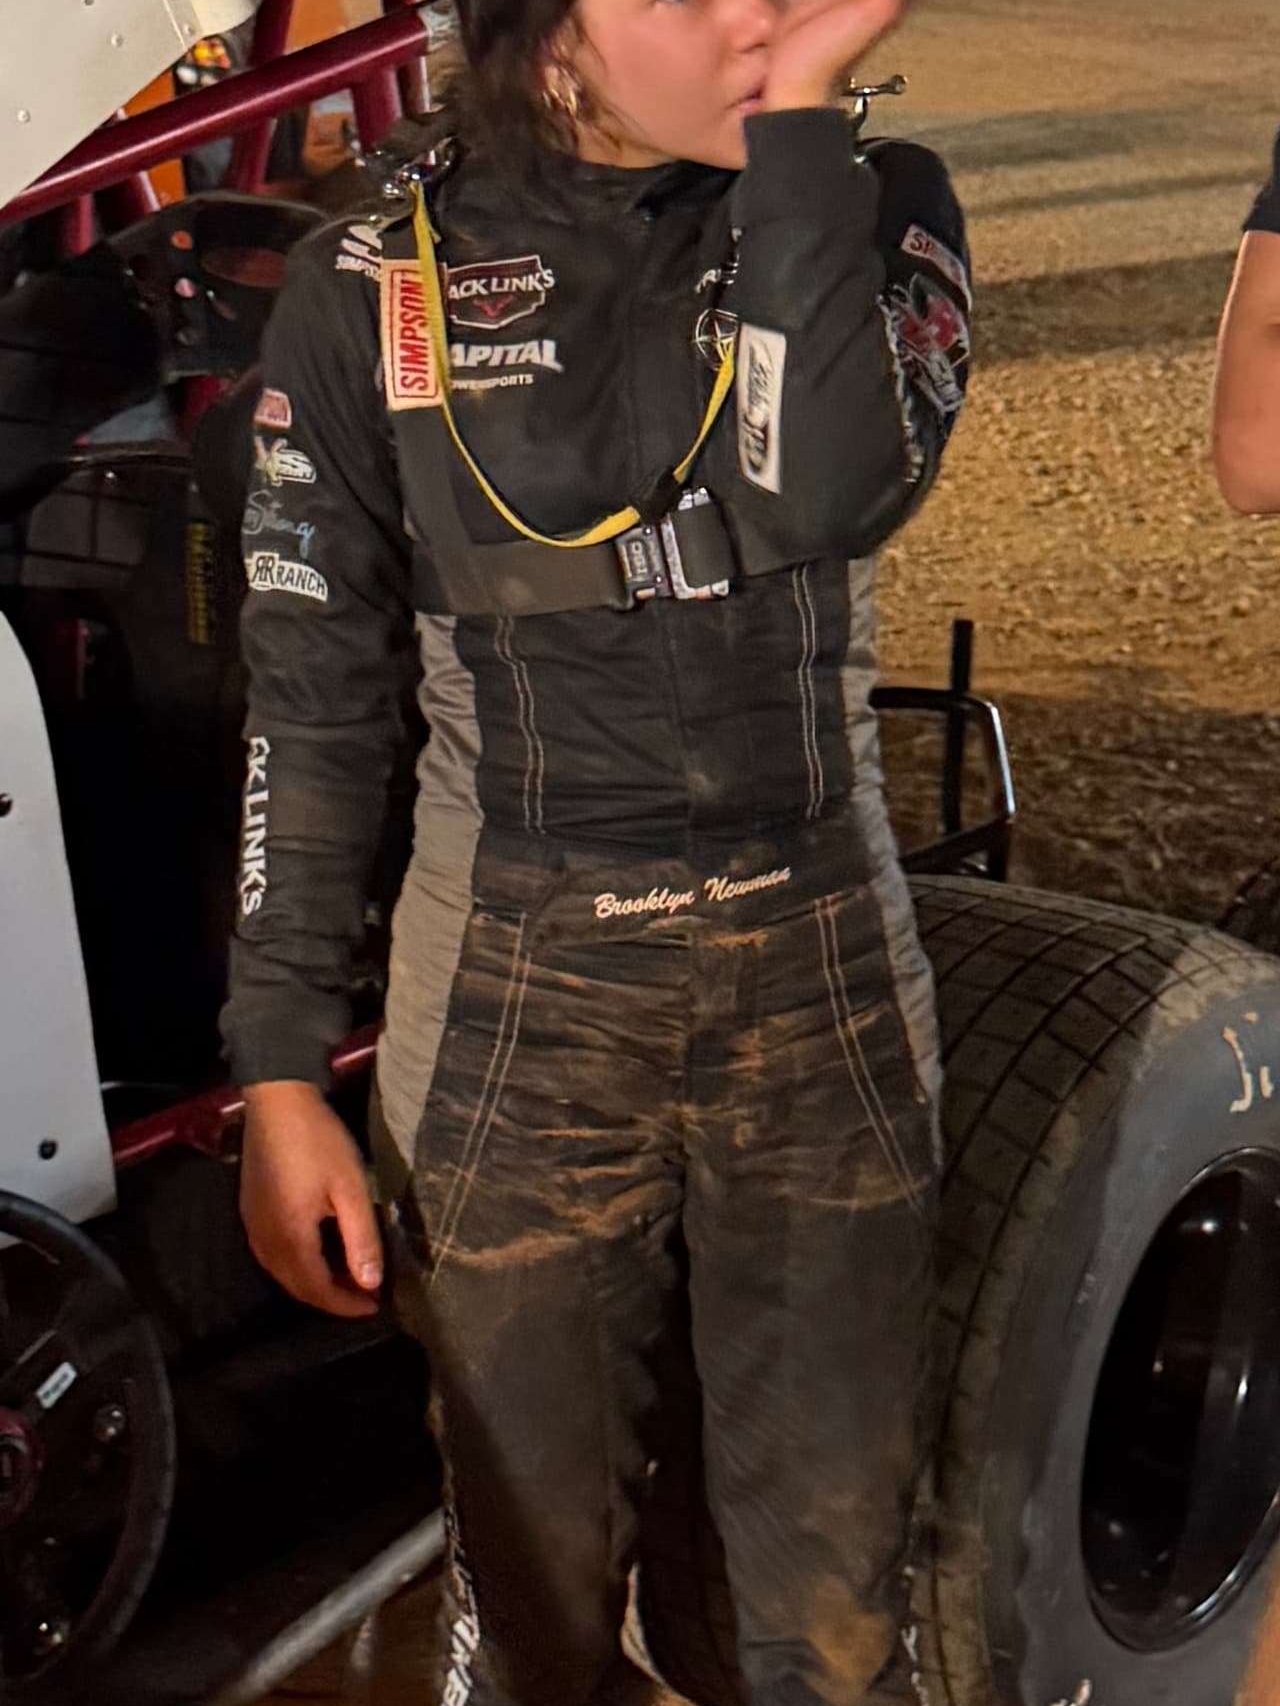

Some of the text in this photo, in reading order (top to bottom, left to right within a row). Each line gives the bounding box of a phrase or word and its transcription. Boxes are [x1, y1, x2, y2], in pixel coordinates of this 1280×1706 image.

[448, 278, 488, 299] ACK
[400, 277, 430, 391] SIMPSON
[451, 339, 563, 372] APITAL
[276, 565, 325, 595] RANCH
[593, 887, 695, 918] Brooklyn
